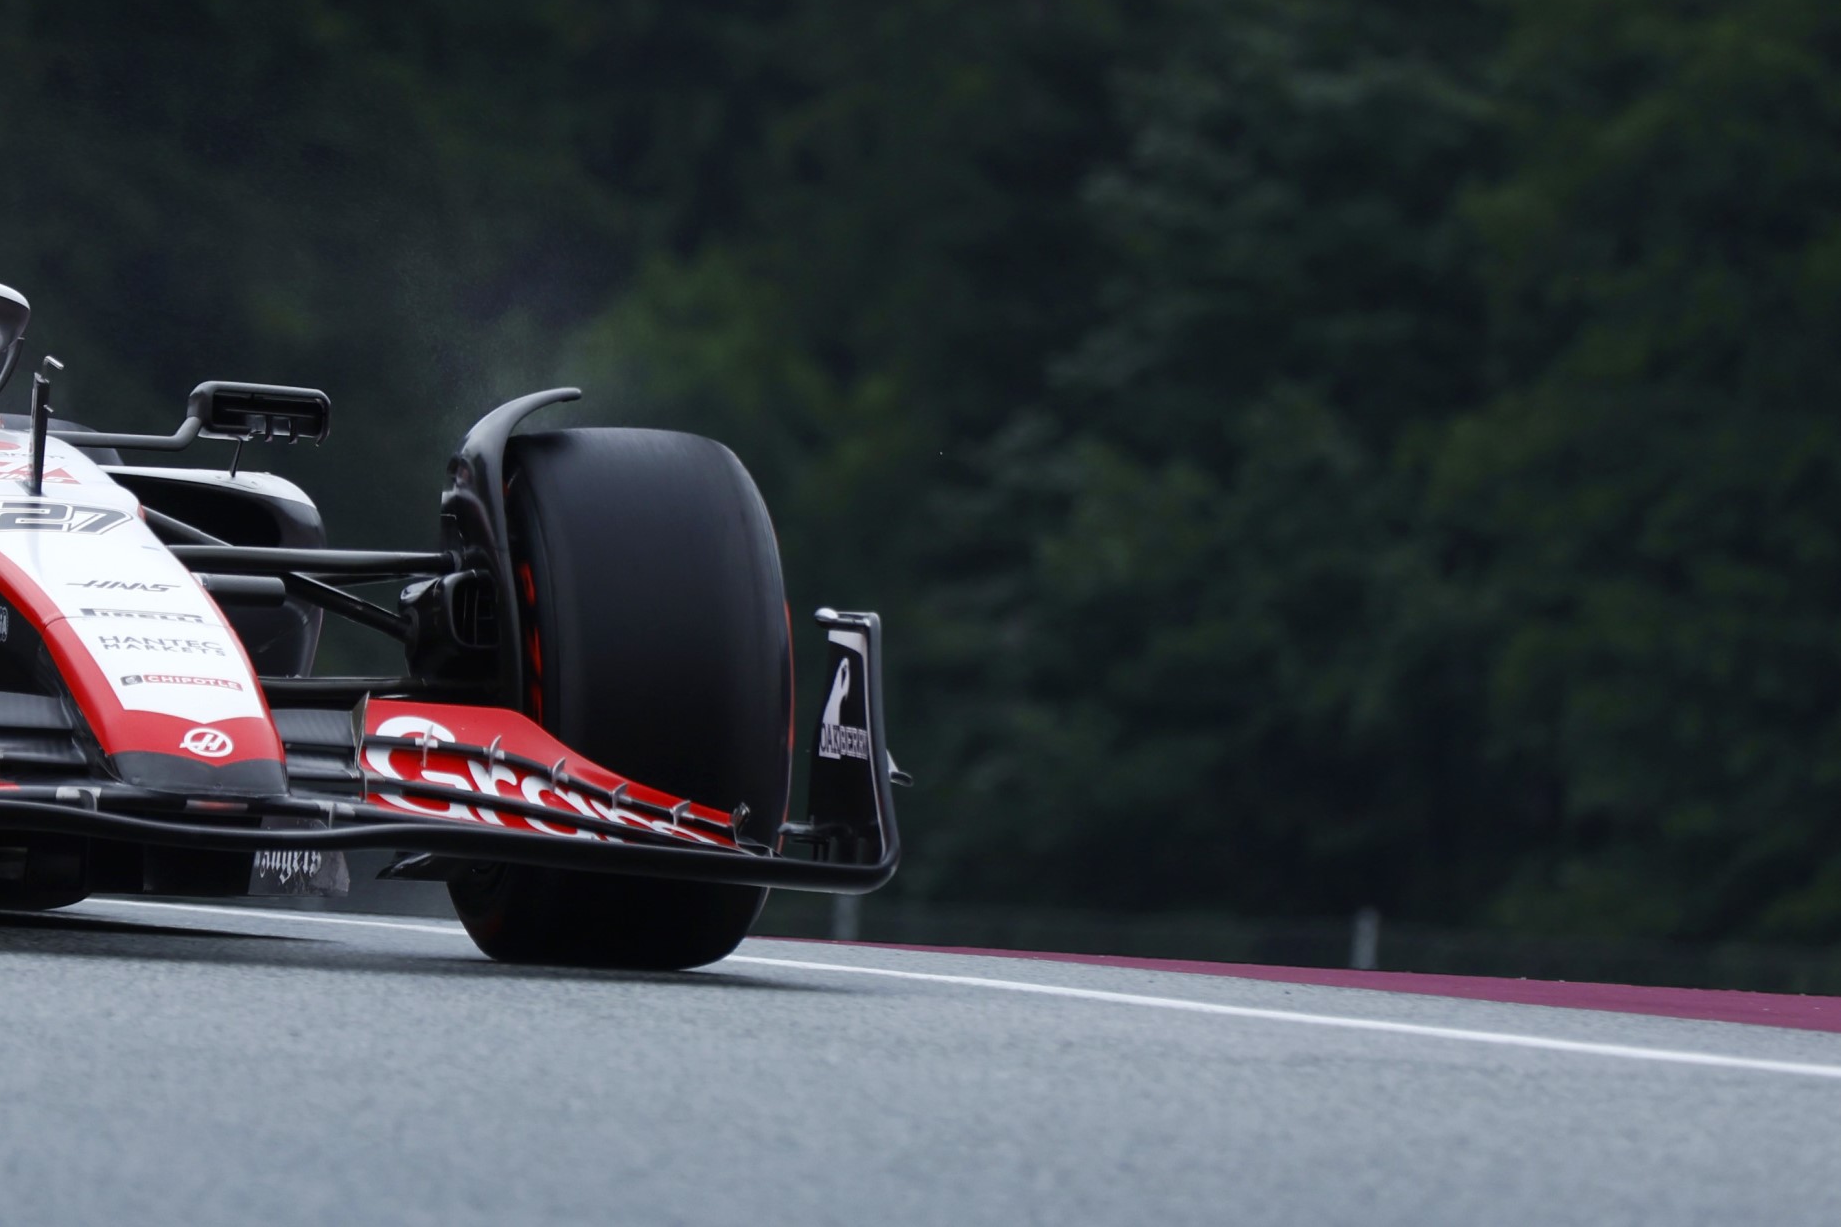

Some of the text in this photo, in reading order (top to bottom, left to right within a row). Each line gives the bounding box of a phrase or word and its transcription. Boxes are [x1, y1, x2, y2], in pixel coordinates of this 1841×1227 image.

[67, 579, 180, 592] HAAS
[98, 635, 223, 651] HANTEC
[102, 643, 226, 657] MARKETS
[147, 676, 239, 690] CHIPOTLE
